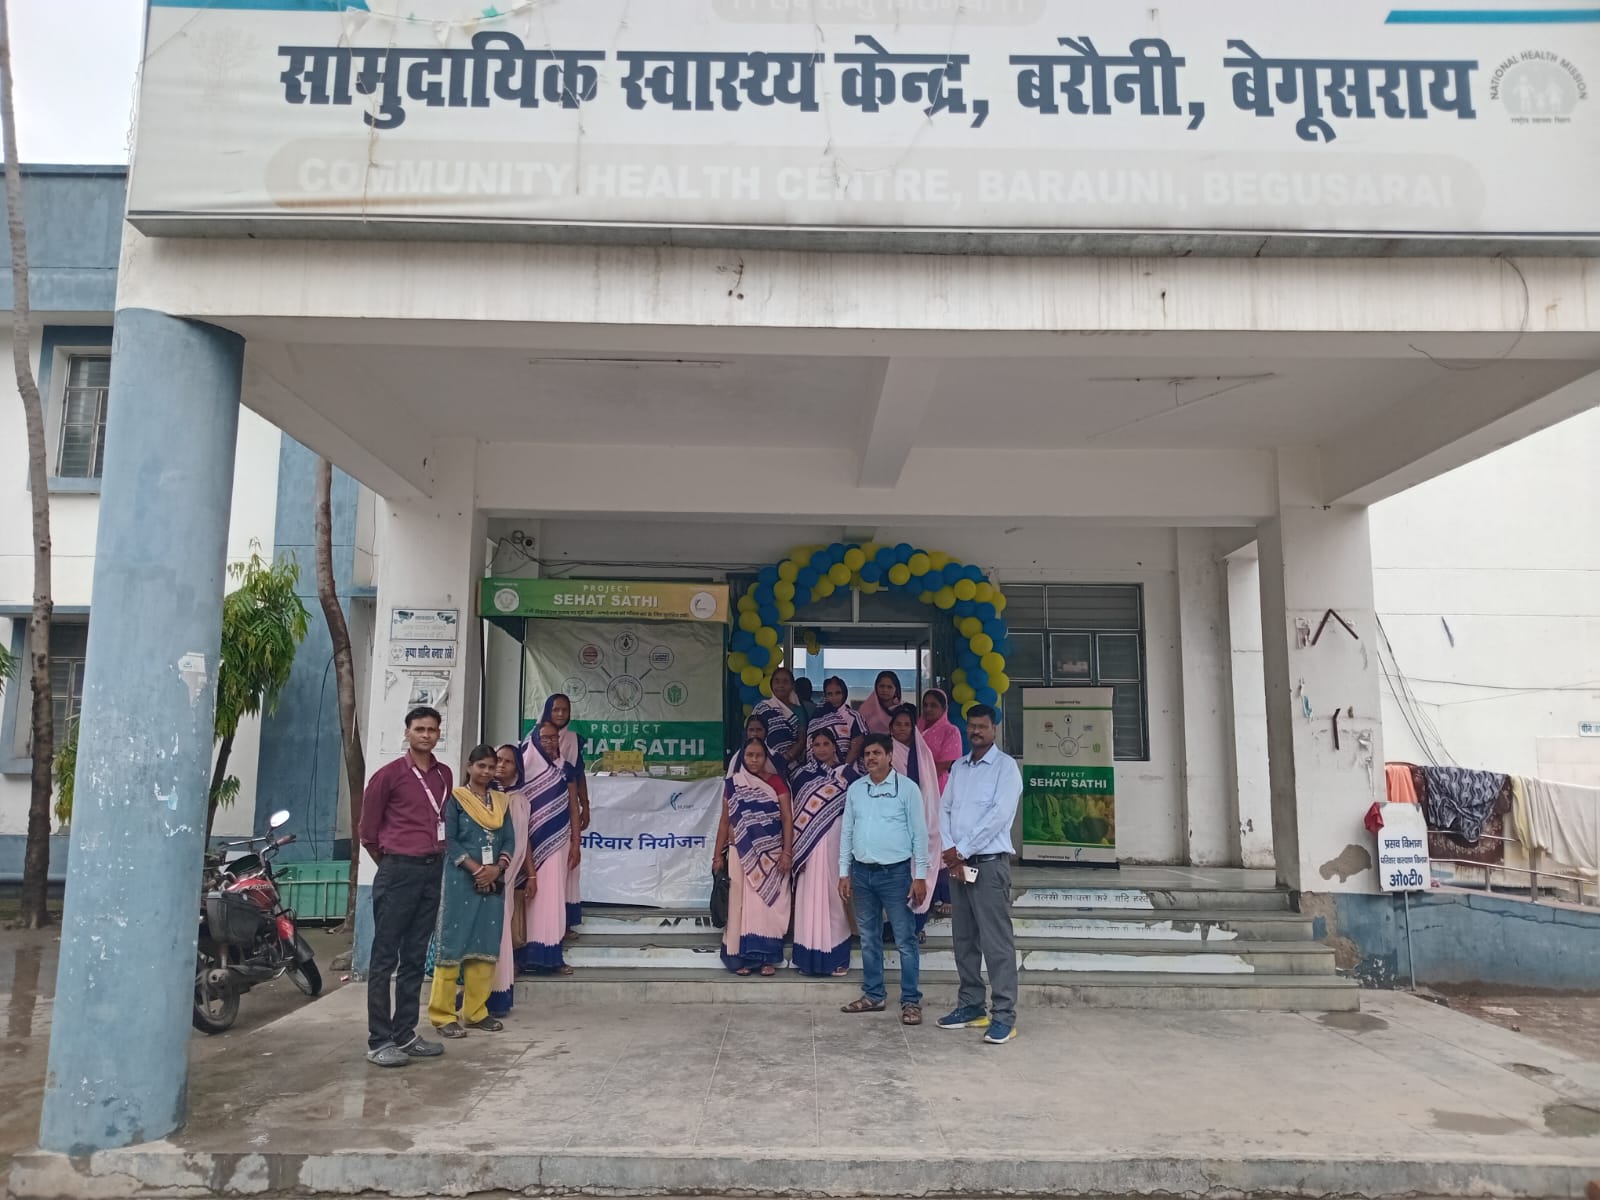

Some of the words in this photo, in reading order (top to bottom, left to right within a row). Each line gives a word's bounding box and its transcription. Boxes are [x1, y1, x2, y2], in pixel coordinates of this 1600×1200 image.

[1490, 55, 1519, 100] NATIONAL
[1520, 51, 1558, 63] HEALTH
[1559, 58, 1587, 99] MISSION
[278, 31, 605, 129] सामुदायिक
[616, 51, 825, 113] स्वास्थ्य
[834, 35, 989, 128] केन्द्र,
[1009, 36, 1205, 130] बरौनी,
[1223, 39, 1479, 143] बेगूसराय
[301, 157, 572, 196] COMMUNITY
[588, 161, 759, 201] HEALTH
[776, 166, 961, 208] CENTRE,
[978, 168, 1187, 210] BARAUNI,
[1201, 171, 1453, 208] BEGUSARAI
[583, 585, 630, 593] PROJECT
[553, 594, 605, 607] SEHAT
[611, 595, 659, 608] SATHI
[591, 723, 662, 736] PROJECT
[583, 738, 625, 755] HAT
[632, 738, 705, 755] SATHI
[1029, 777, 1068, 788] SEHAT
[1071, 779, 1107, 789] SATHI
[638, 832, 708, 850] नियोजन
[1402, 836, 1422, 849] विभाग
